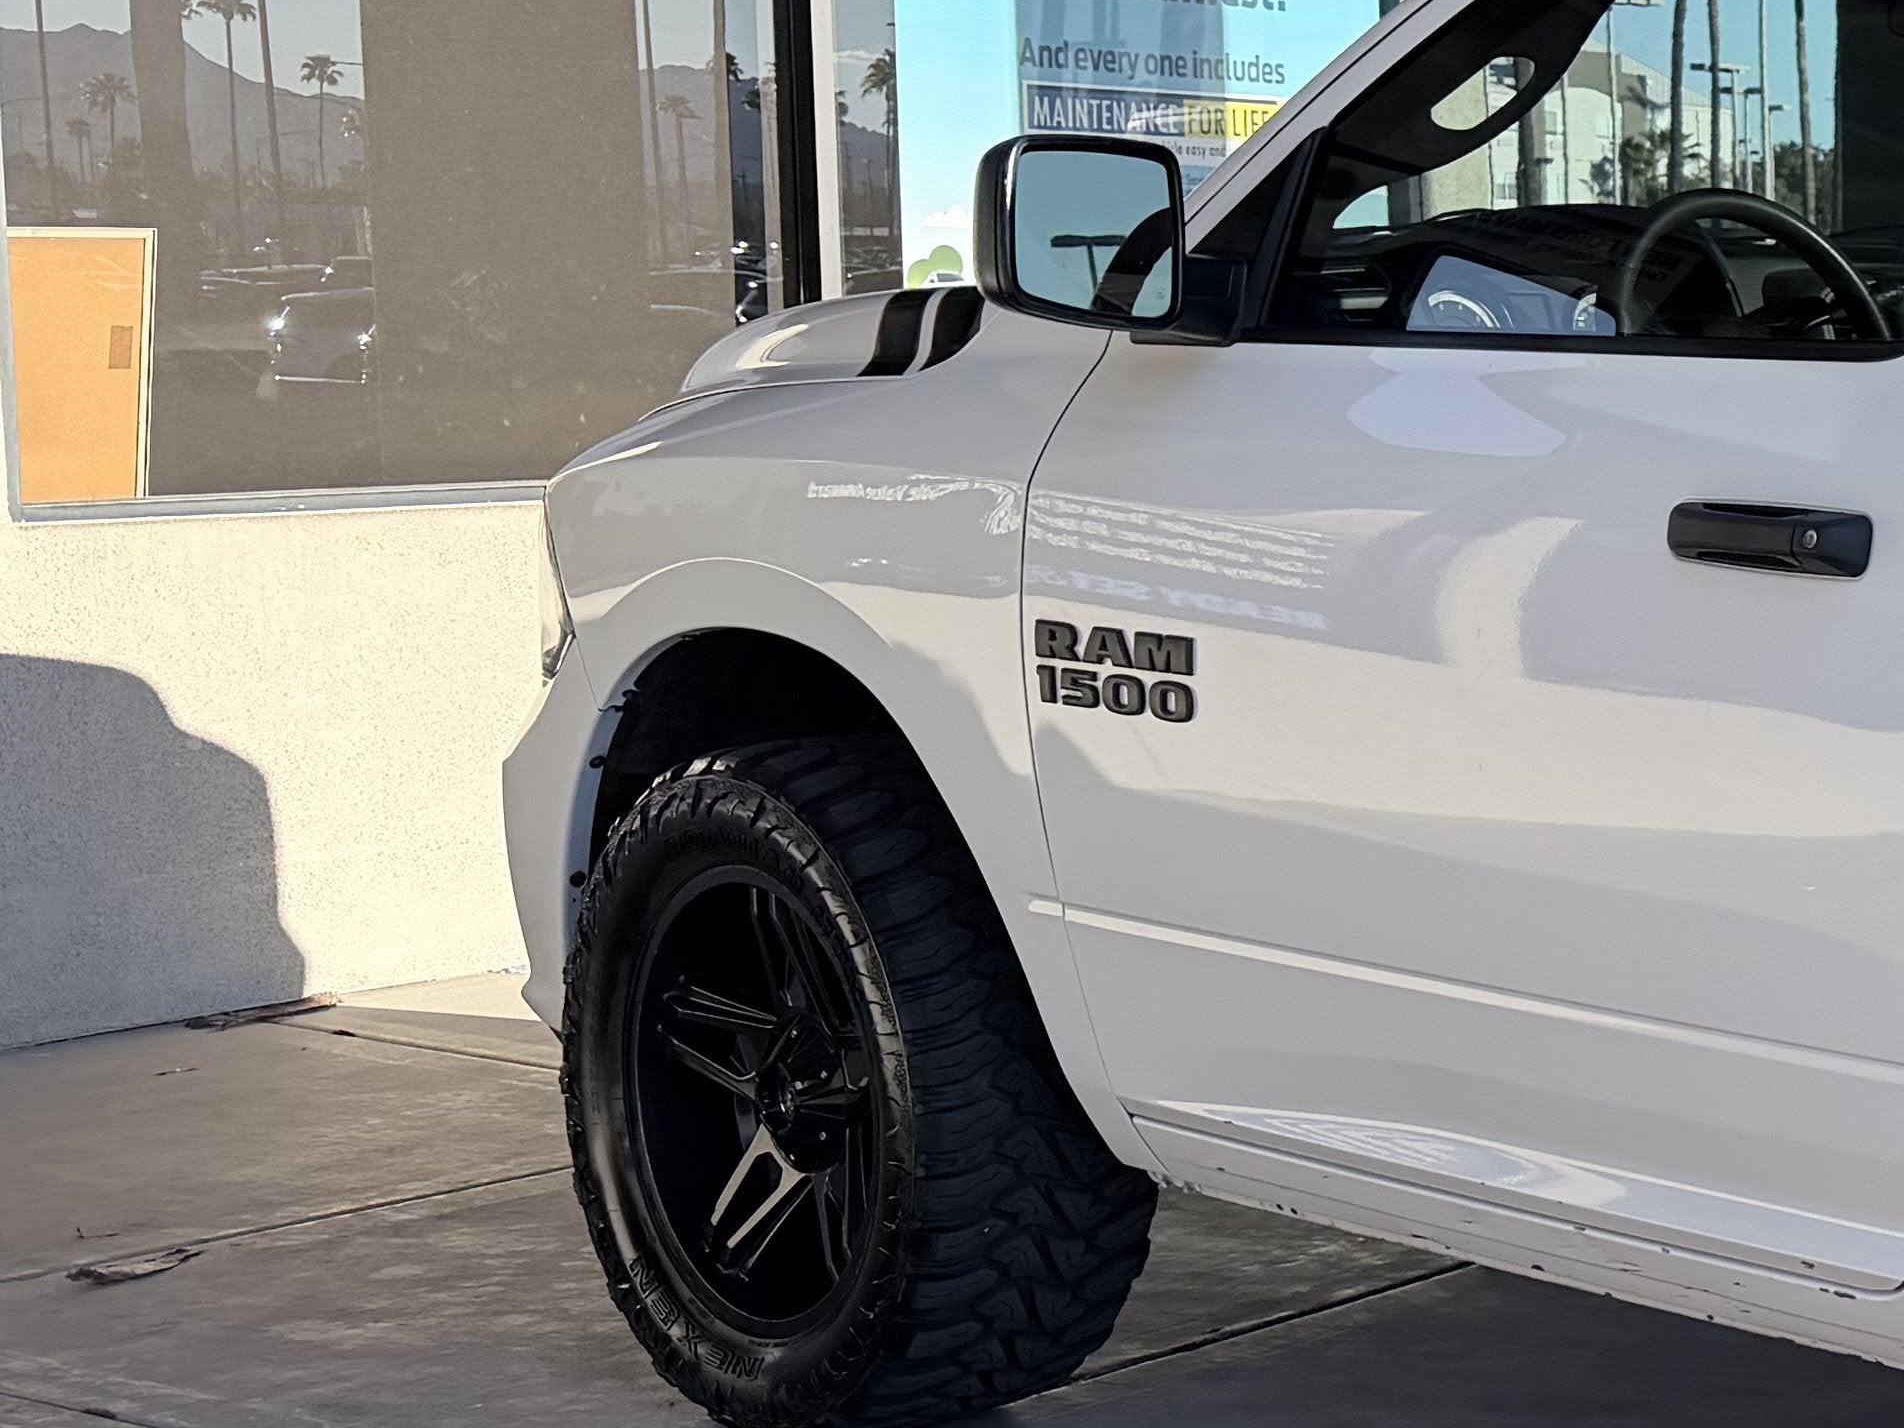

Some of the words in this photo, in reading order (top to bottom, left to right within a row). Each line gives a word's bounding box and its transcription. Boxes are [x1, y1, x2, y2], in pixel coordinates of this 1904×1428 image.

[1019, 36, 1069, 70] And
[1074, 47, 1140, 80] every
[1144, 53, 1188, 78] one
[1192, 50, 1286, 85] includes
[1033, 95, 1180, 134] MAINTENANCE
[1188, 105, 1226, 137] FOR
[1035, 618, 1195, 676] RAM
[1036, 664, 1195, 723] 1500
[626, 1257, 765, 1382] NEXEN
